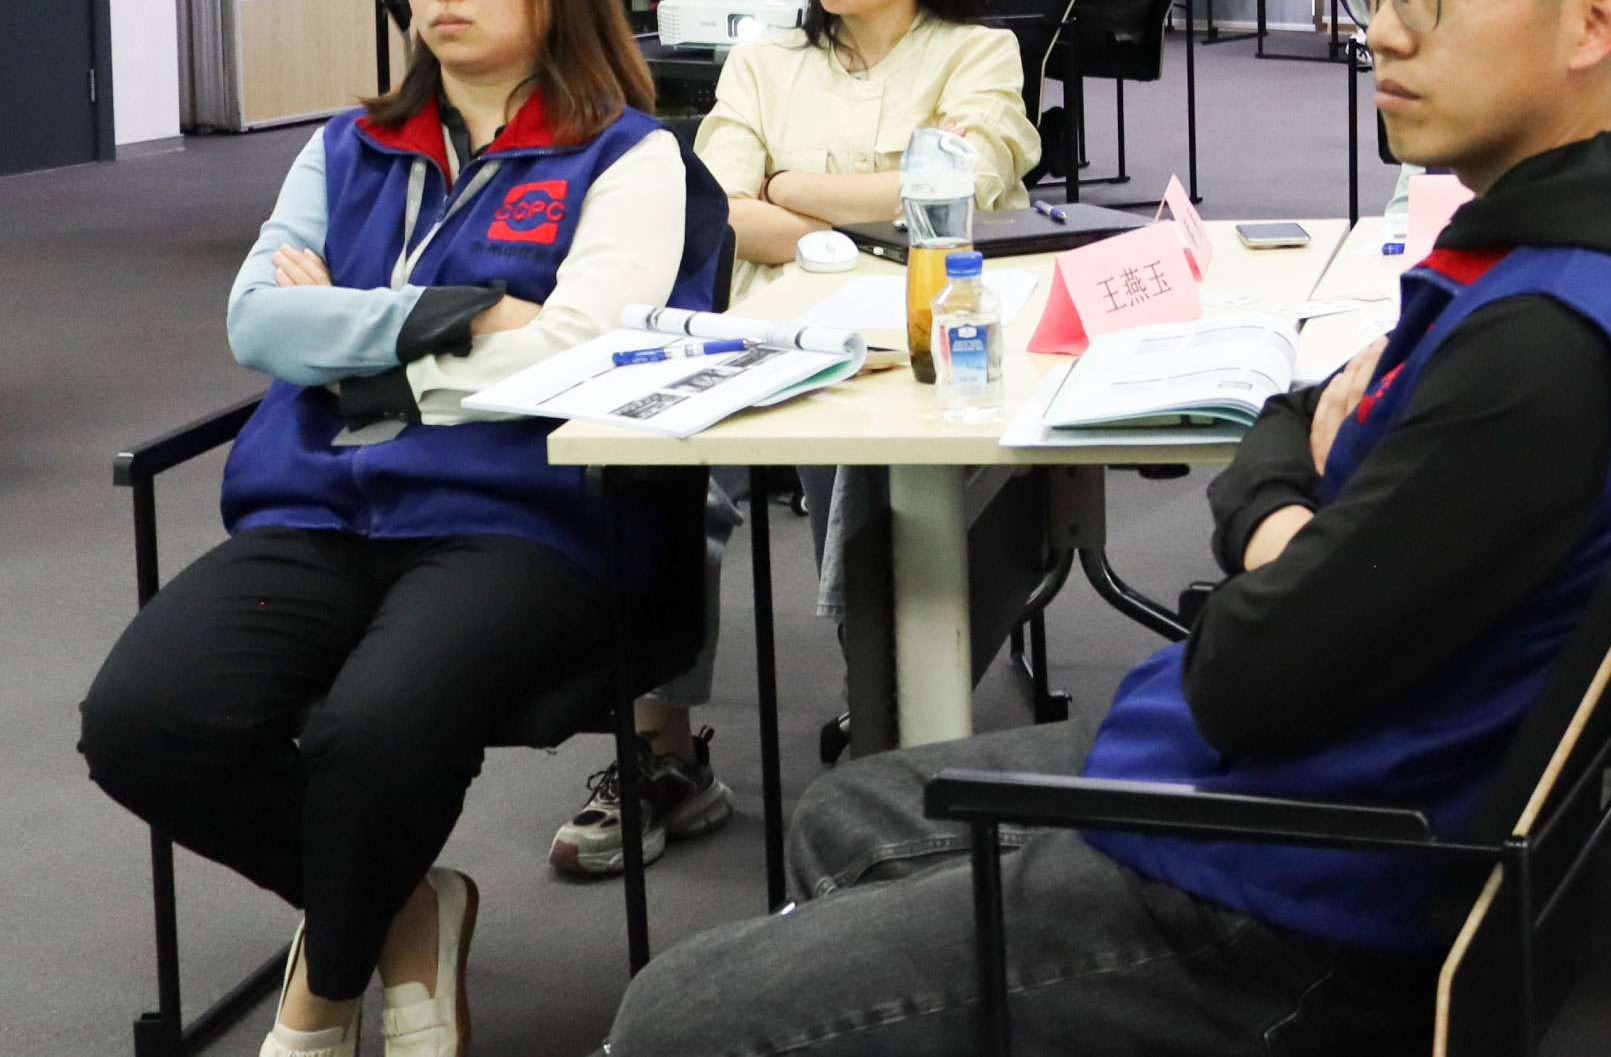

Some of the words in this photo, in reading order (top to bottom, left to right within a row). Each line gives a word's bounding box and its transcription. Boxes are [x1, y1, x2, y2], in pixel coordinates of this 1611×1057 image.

[494, 200, 566, 222] CCPC
[1096, 260, 1172, 314] 王燕玉
